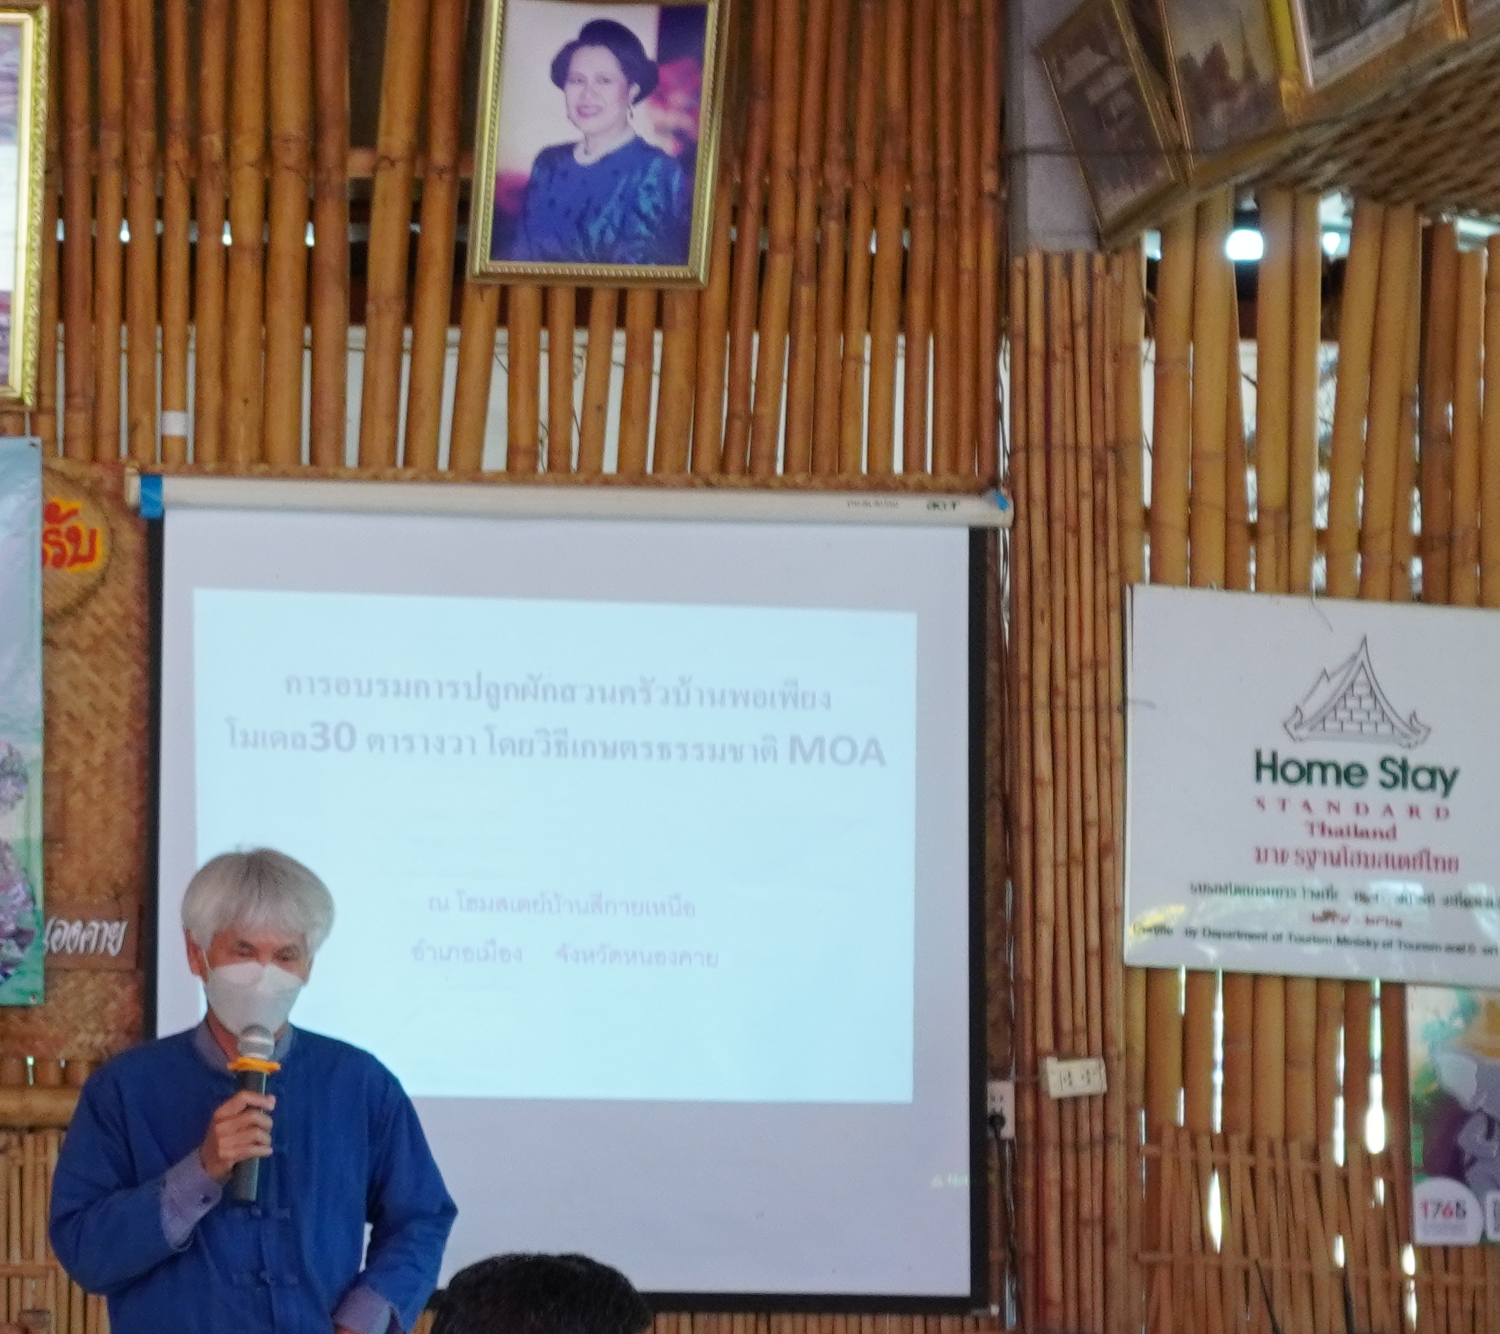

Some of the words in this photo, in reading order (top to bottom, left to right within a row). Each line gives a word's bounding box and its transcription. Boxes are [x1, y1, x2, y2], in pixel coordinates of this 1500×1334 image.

[788, 733, 888, 767] MOA
[1254, 748, 1369, 788] Home
[1378, 755, 1461, 798] Stay
[1255, 796, 1450, 820] STANDARD
[1305, 820, 1397, 841] Thailand
